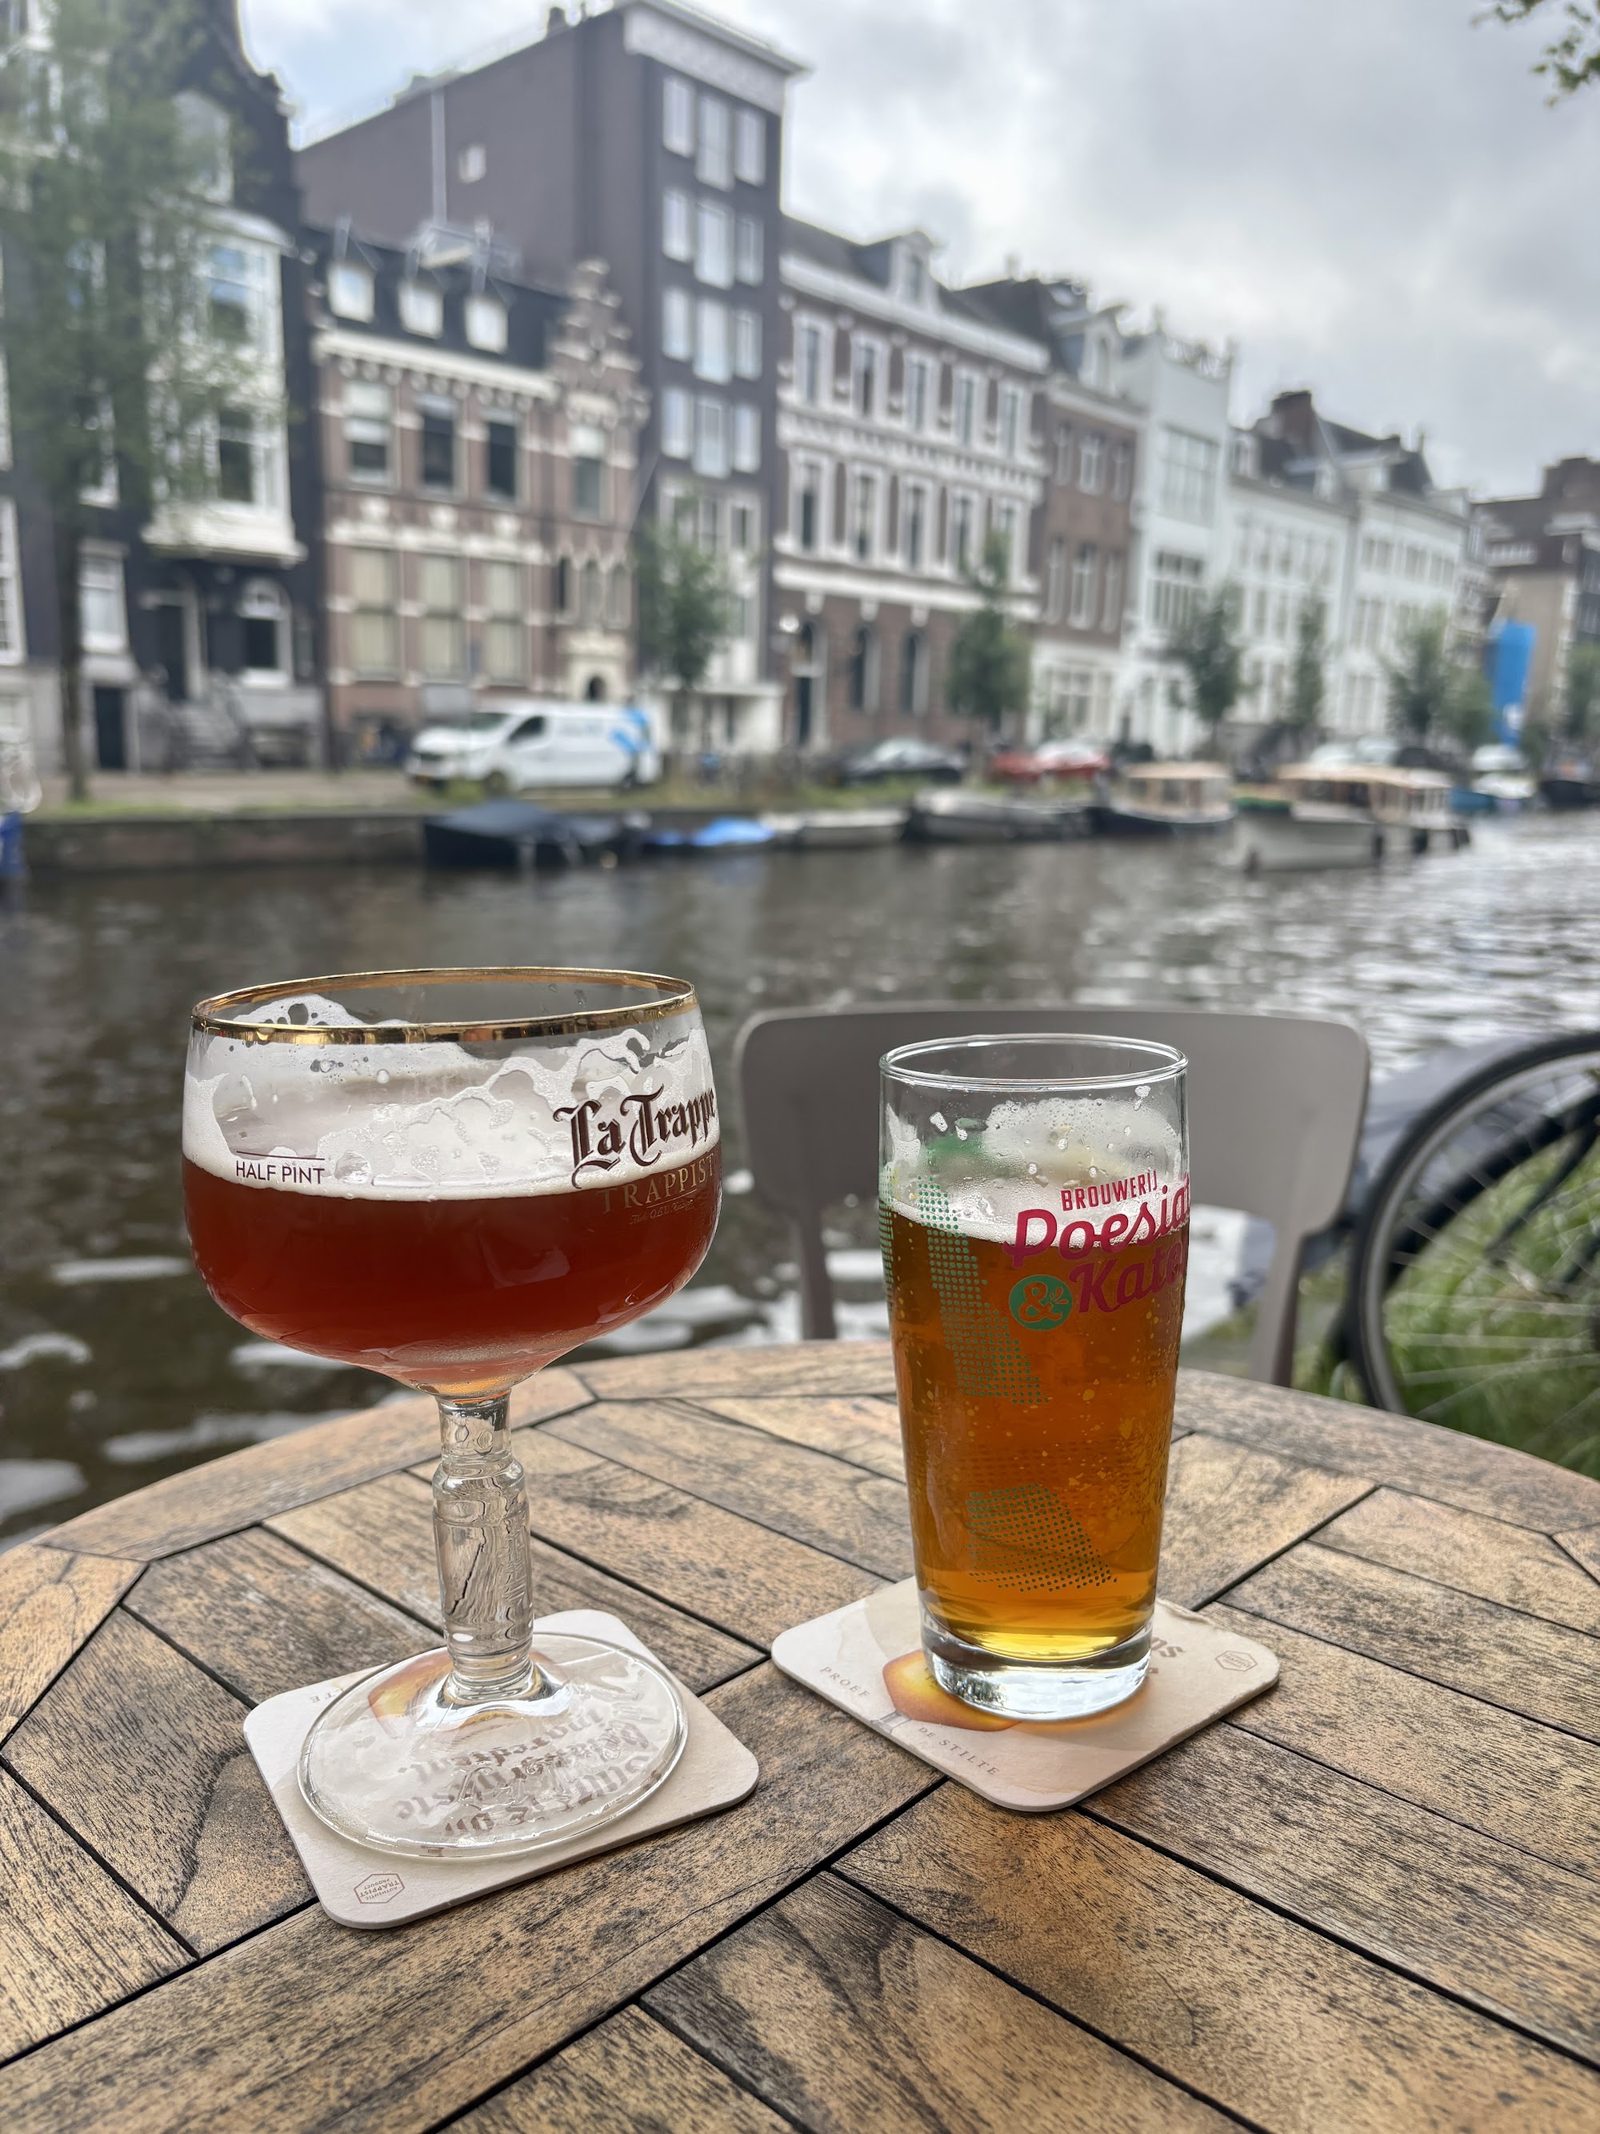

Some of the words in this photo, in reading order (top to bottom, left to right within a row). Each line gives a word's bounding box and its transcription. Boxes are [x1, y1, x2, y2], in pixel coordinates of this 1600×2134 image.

[553, 1099, 627, 1189] La
[236, 1160, 276, 1180] HALF
[282, 1166, 325, 1184] PINT
[598, 1152, 715, 1215] TRAPPIST
[1061, 1168, 1158, 1212] BROUWERIJ
[1069, 1240, 1184, 1313] Kate
[819, 1666, 871, 1698] PROEF
[918, 1726, 936, 1738] DE
[939, 1739, 1000, 1776] STILTE
[360, 1880, 400, 1898] TRAPPIST
[364, 1878, 390, 1890] PRODUCT
